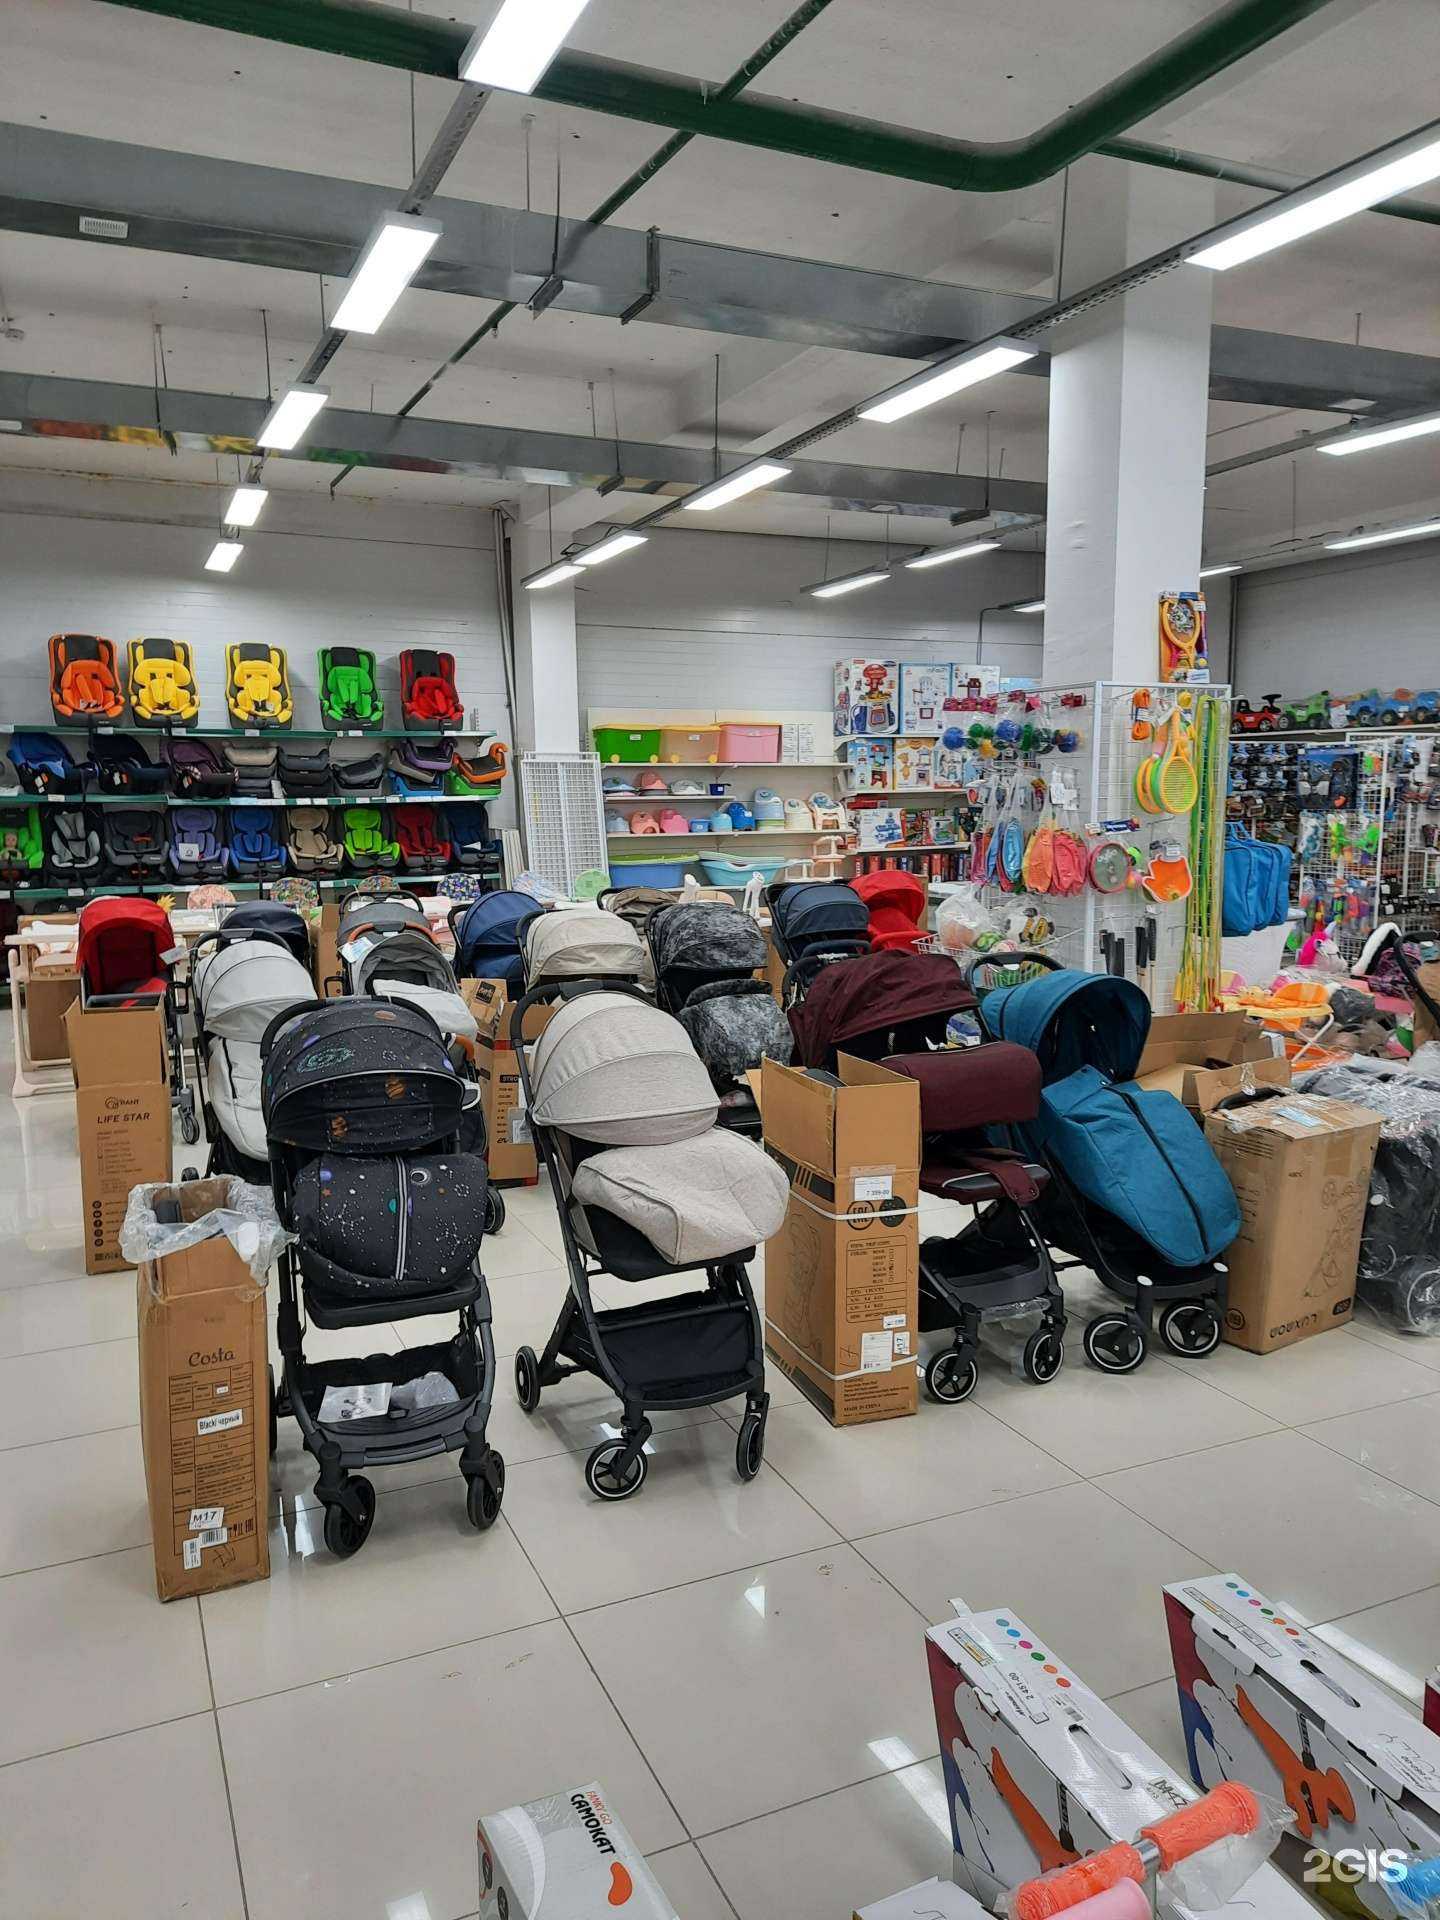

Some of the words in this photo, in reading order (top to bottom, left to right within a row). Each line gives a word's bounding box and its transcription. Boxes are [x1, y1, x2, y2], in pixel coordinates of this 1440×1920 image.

[97, 1114, 120, 1124] LIFE
[123, 1112, 151, 1122] STAR
[188, 1347, 236, 1367] Costa
[193, 1511, 218, 1521] M17
[570, 1794, 616, 1855] САМОКАТ
